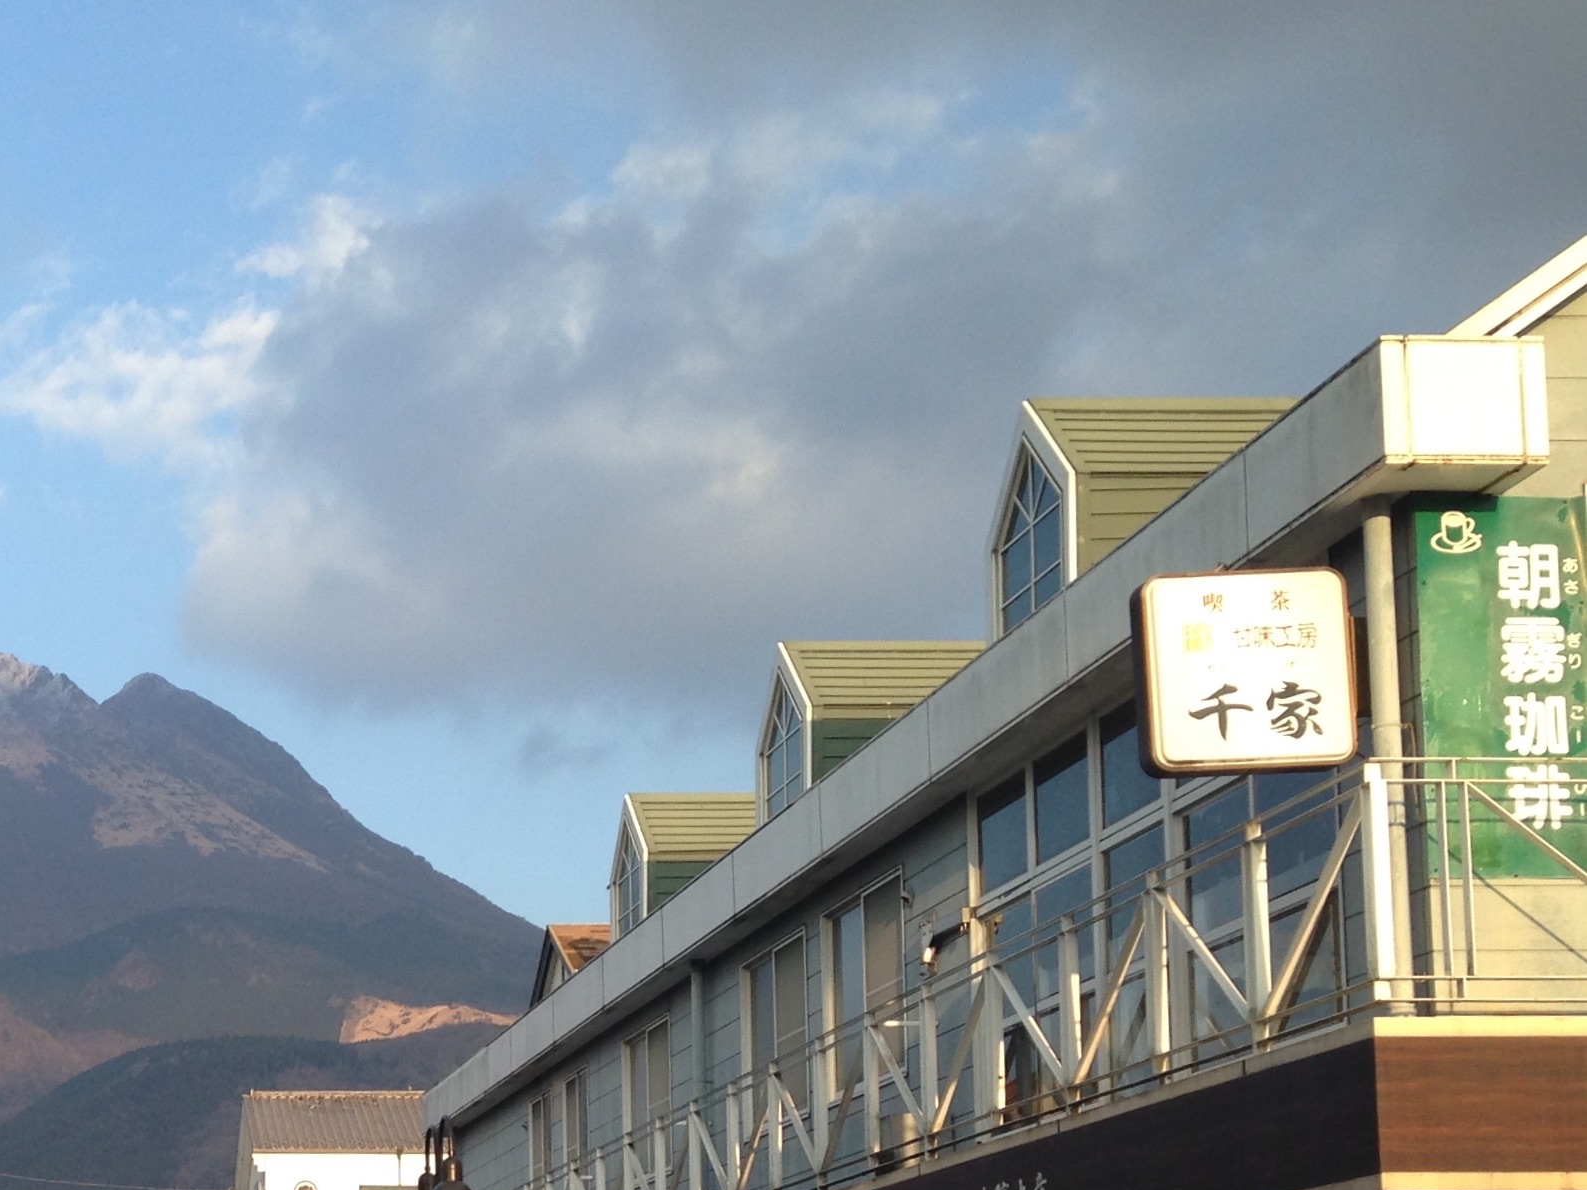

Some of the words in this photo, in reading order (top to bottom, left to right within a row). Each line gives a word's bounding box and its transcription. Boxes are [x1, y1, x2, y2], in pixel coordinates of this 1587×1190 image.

[1232, 622, 1318, 649] 甘味工房
[1188, 680, 1324, 742] 千家
[1496, 540, 1573, 830] 朝霧珈琲
